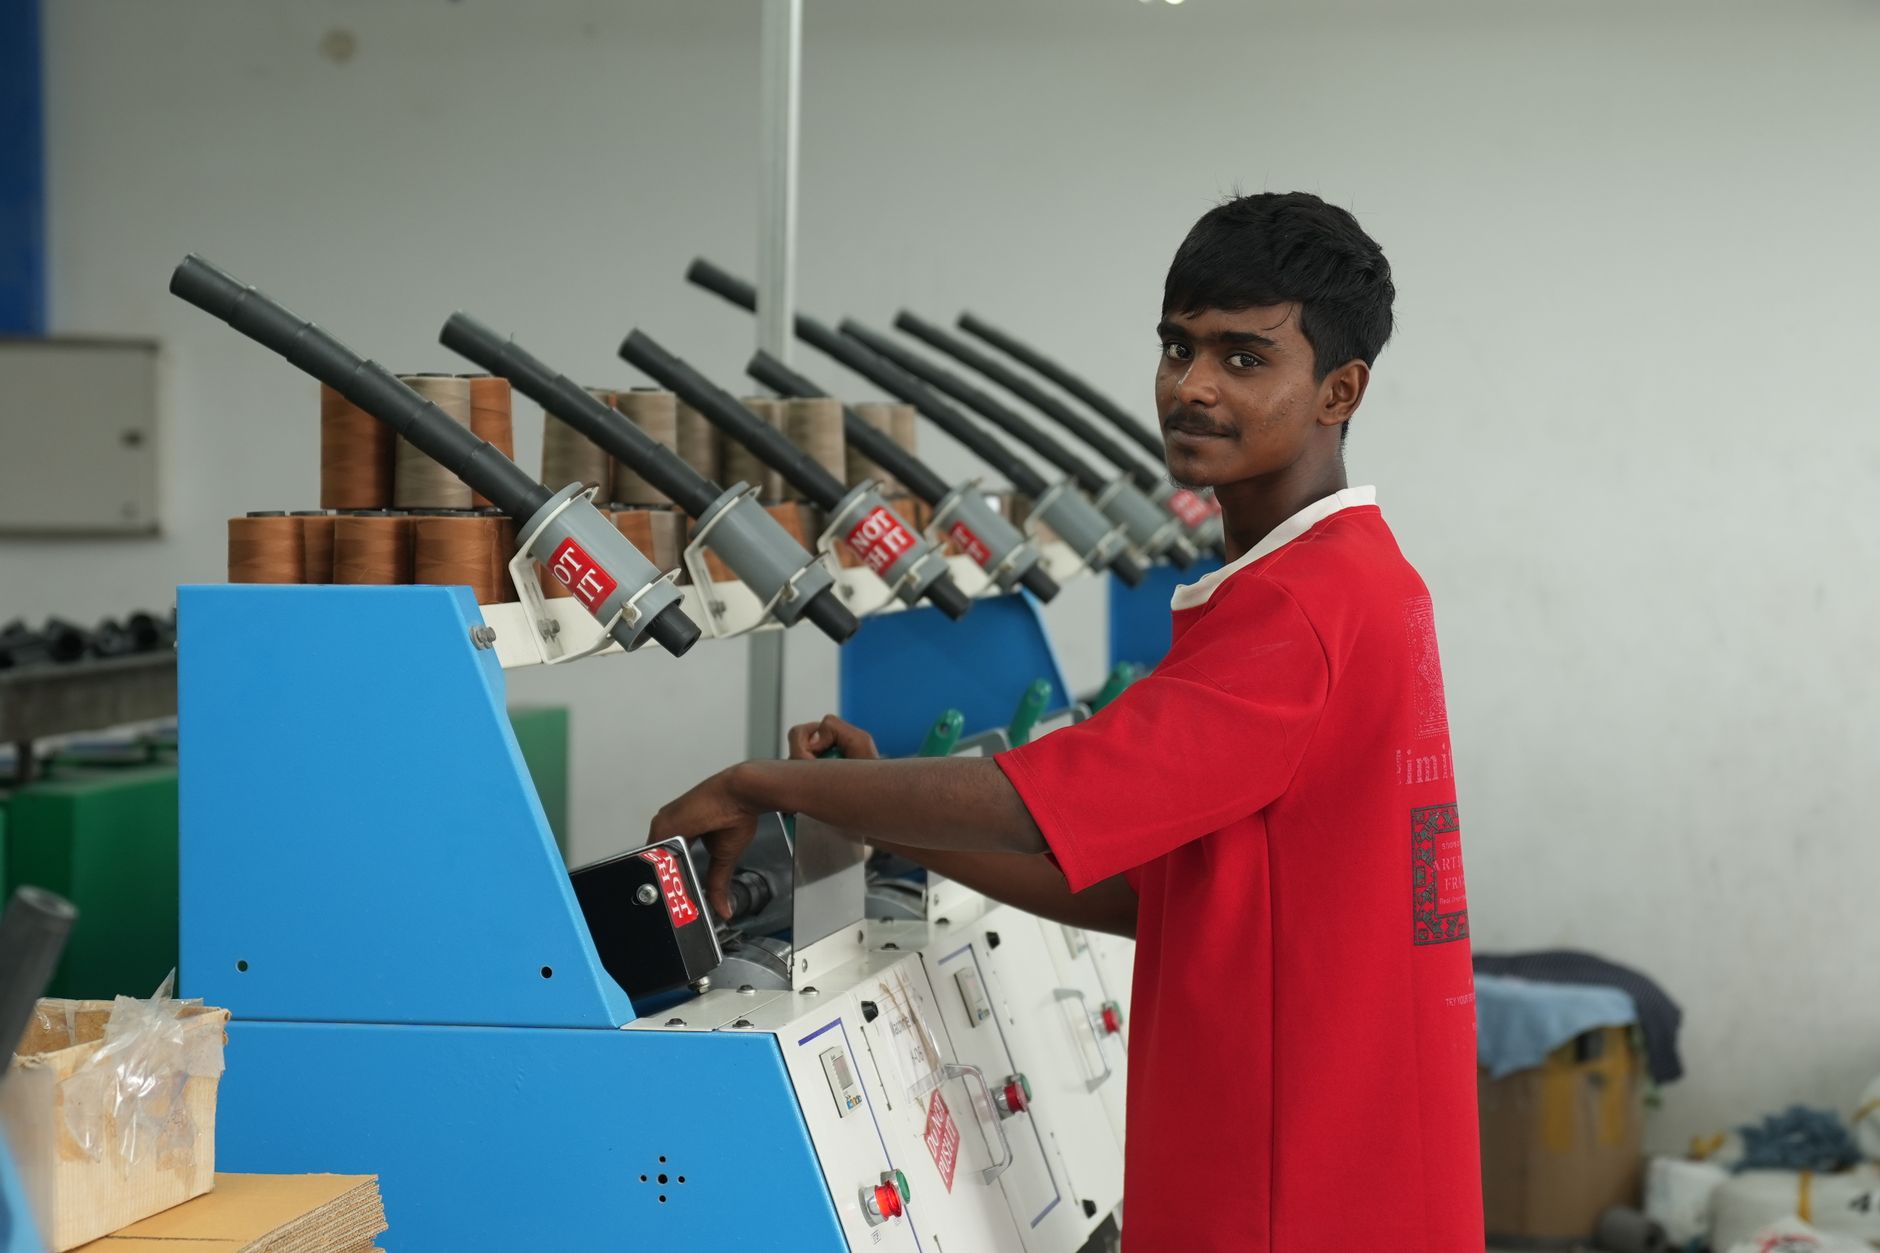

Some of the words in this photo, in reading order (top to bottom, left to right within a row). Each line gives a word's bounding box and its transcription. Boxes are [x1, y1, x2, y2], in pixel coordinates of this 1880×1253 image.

[851, 509, 892, 552] NOT
[883, 525, 908, 553] IT
[552, 546, 582, 587] OT
[1433, 855, 1464, 872] ARTI
[662, 855, 693, 915] NOT
[667, 889, 684, 919] IT
[938, 1133, 953, 1185] PUSH
